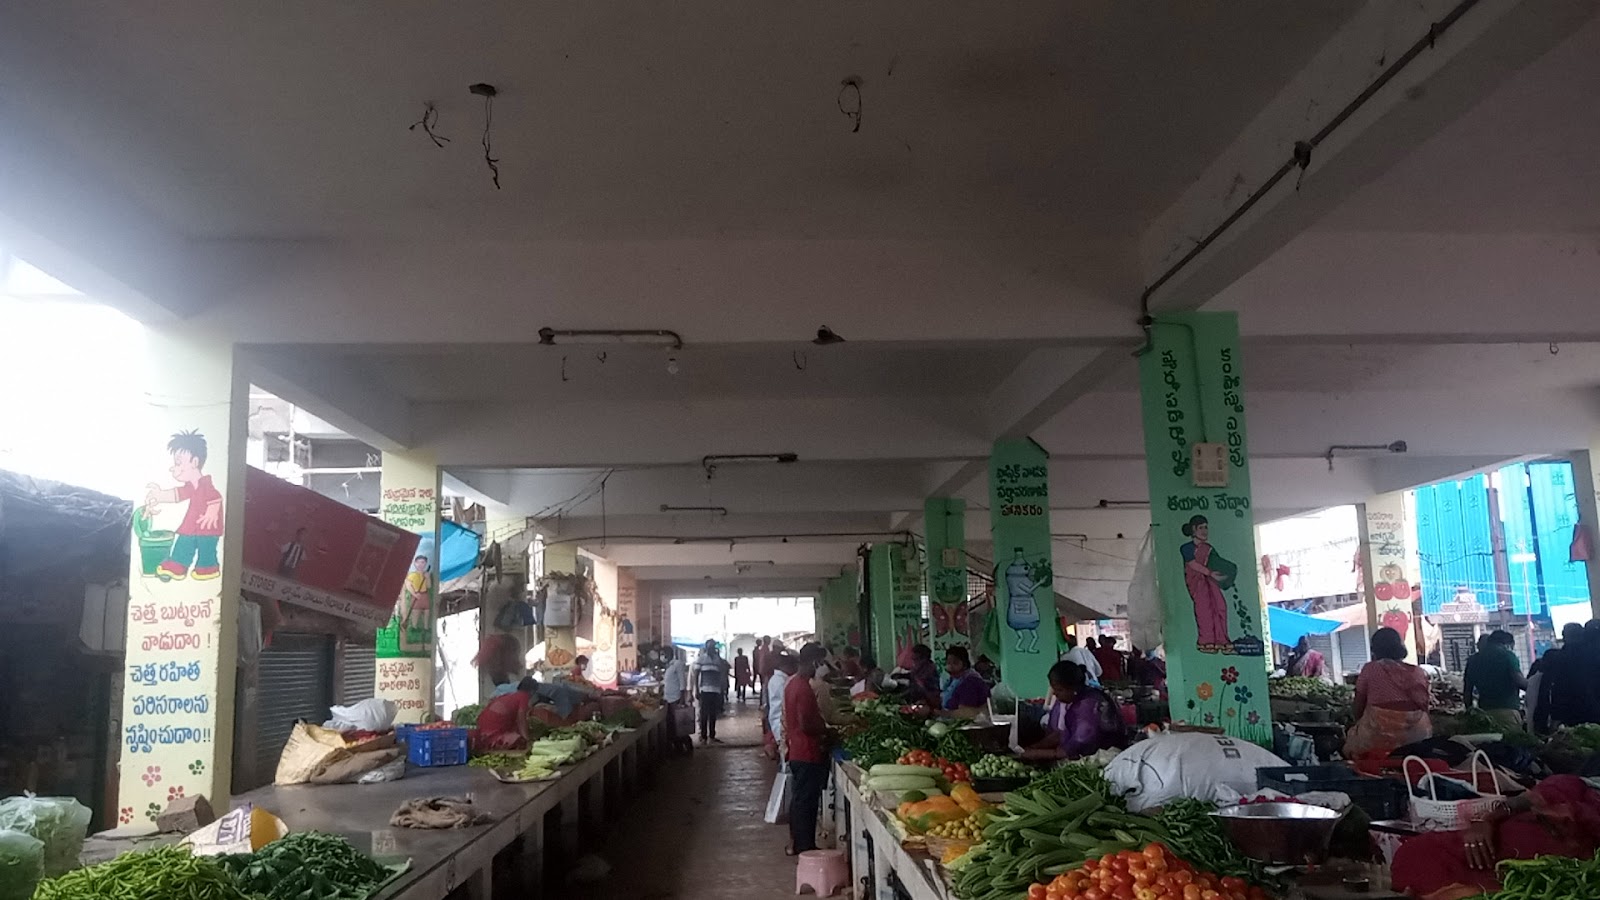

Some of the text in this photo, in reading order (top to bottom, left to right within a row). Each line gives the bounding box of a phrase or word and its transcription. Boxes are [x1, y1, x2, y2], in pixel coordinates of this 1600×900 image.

[130, 602, 159, 625] చెత్త
[141, 633, 201, 651] వాడుదాం
[129, 660, 201, 687] చెత్త రహిత
[132, 694, 210, 716] పరిసరాలను
